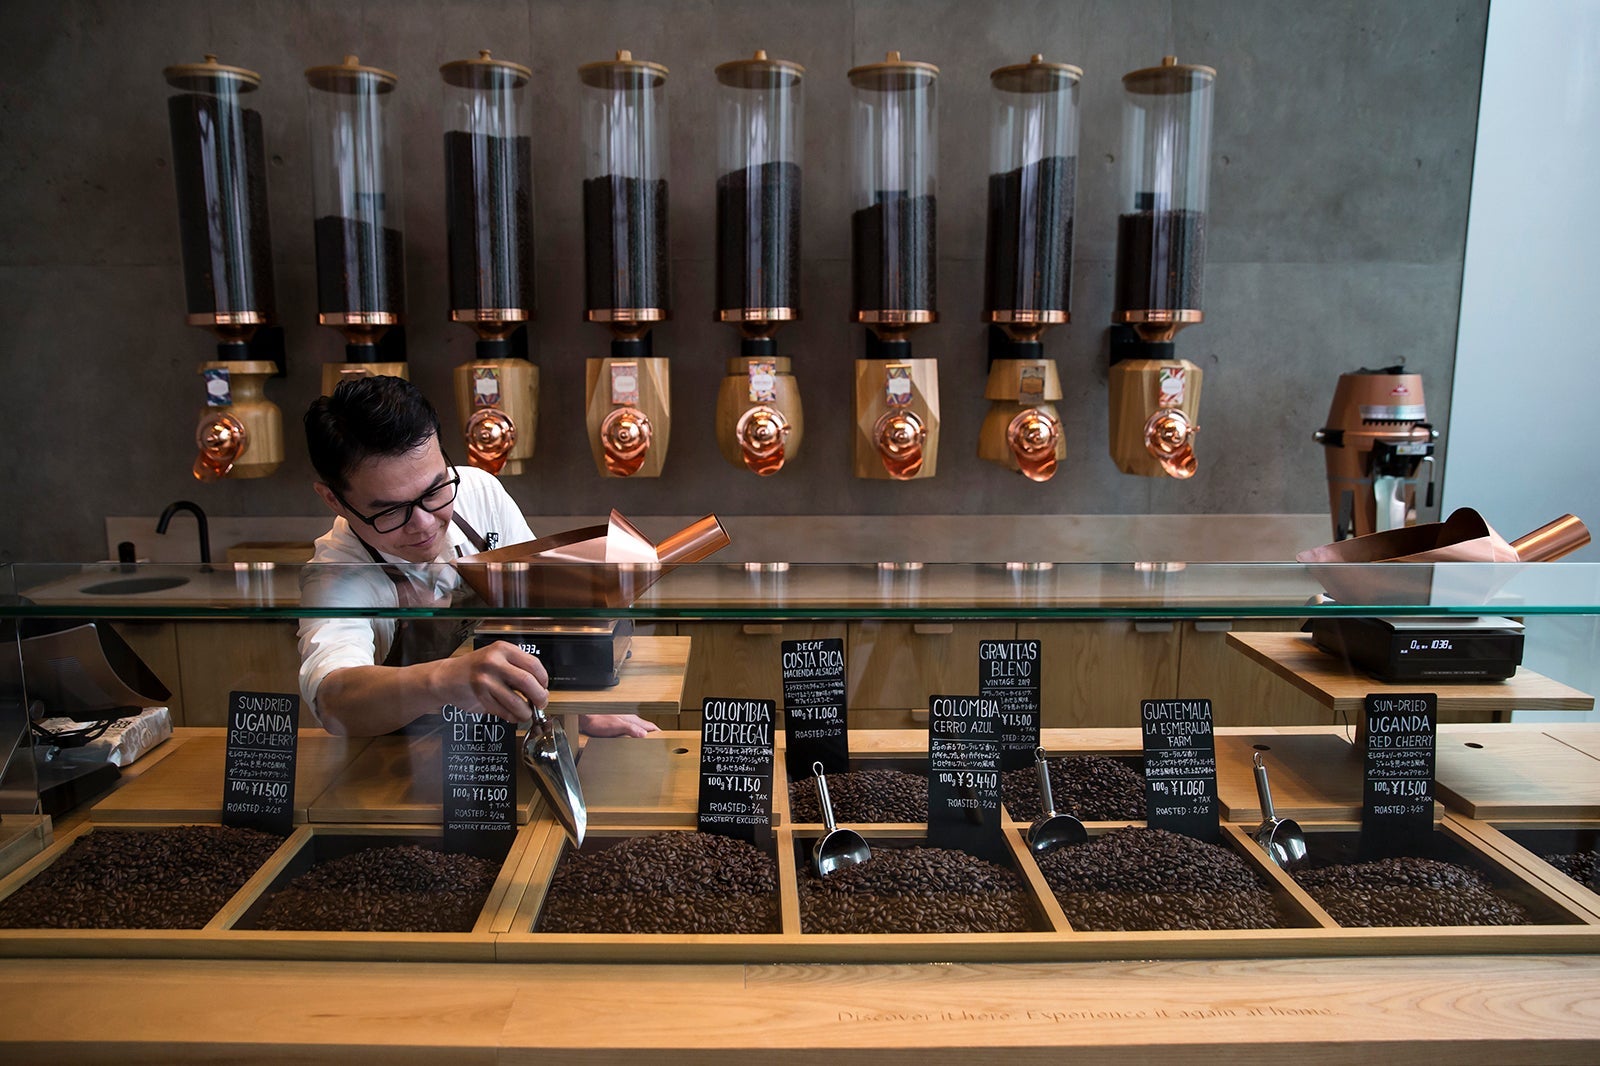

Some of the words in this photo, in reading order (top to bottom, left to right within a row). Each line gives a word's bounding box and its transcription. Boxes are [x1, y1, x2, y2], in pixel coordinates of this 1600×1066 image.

[797, 641, 824, 651] DECAF
[980, 642, 1037, 660] GRAVITAS
[784, 652, 816, 668] COSTA
[820, 650, 844, 667] RICA
[784, 669, 814, 678] HACIENDA
[992, 661, 1032, 677] BLEND
[705, 701, 770, 722] COLOMBIA
[934, 699, 1000, 718] COLOMBIA
[1144, 702, 1211, 720] GUATEMALA
[1374, 700, 1427, 712] SUN-DRIED
[236, 713, 292, 733] UGANDA
[934, 720, 966, 733] CERRO
[970, 721, 994, 733] AZUL
[1146, 723, 1157, 734] LA
[1160, 721, 1211, 735] ESMERALDA
[1370, 715, 1430, 733] UGANDA
[454, 724, 505, 742] BLEND
[705, 723, 771, 745] PEDREGAL
[1167, 736, 1192, 747] FARM
[1369, 736, 1392, 747] RED
[1396, 735, 1434, 747] CHERRY
[838, 1010, 929, 1022] Discover
[1026, 1008, 1146, 1024] Experience
[1180, 1007, 1236, 1020] again
[1247, 1006, 1266, 1017] at
